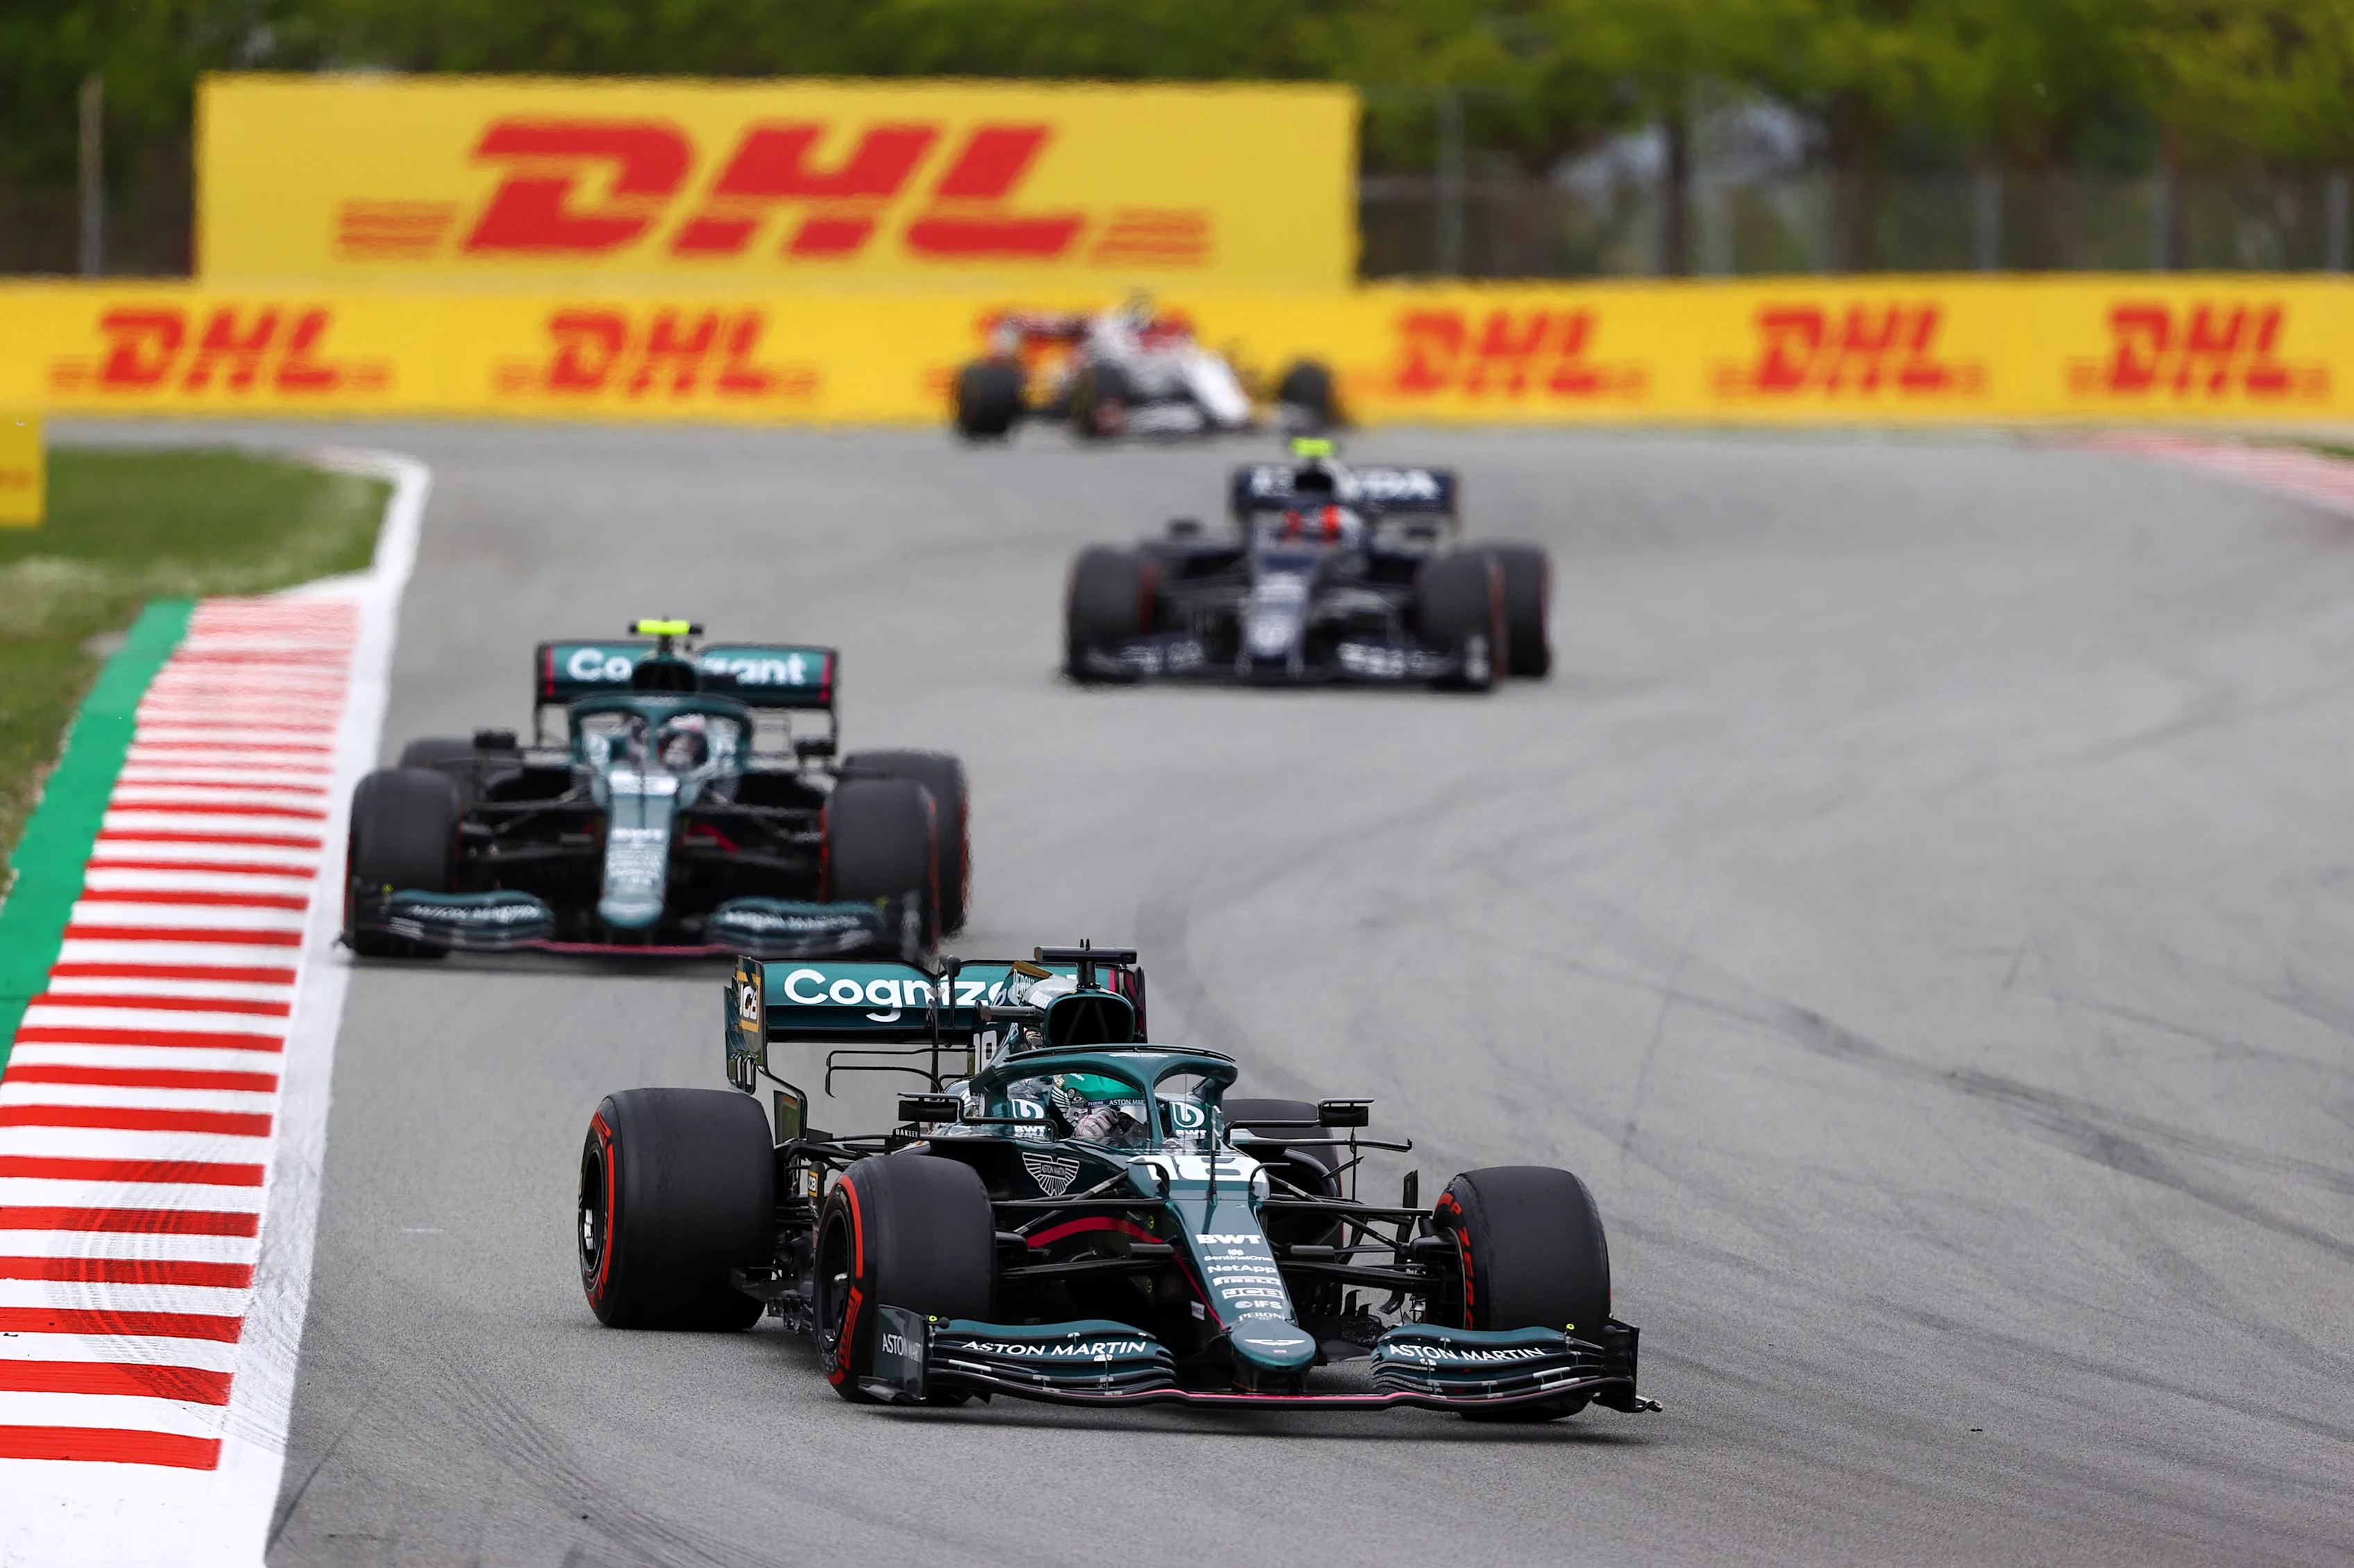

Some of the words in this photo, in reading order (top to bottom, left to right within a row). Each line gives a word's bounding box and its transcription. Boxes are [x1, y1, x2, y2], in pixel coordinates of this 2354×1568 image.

[462, 119, 1085, 259] DHL
[99, 309, 339, 391] DHL
[547, 311, 768, 393] DHL
[1396, 312, 1601, 394] DHL
[1750, 307, 1952, 393] DHL
[2103, 305, 2293, 394] DHL
[567, 647, 808, 687] Coant
[784, 969, 1077, 1023] Cogniz
[895, 1128, 918, 1139] OAKLEY
[808, 1175, 817, 1192] CB
[1195, 1234, 1262, 1245] BWT
[1207, 1264, 1278, 1274] NetApp
[1223, 1288, 1283, 1298] JCB
[1254, 1300, 1282, 1309] IFS
[882, 1333, 908, 1357] ASTON
[962, 1340, 1046, 1356] ASTON
[1051, 1341, 1147, 1356] MARTIN
[1389, 1343, 1459, 1361] ASTON
[1460, 1347, 1547, 1361] MARTIN
